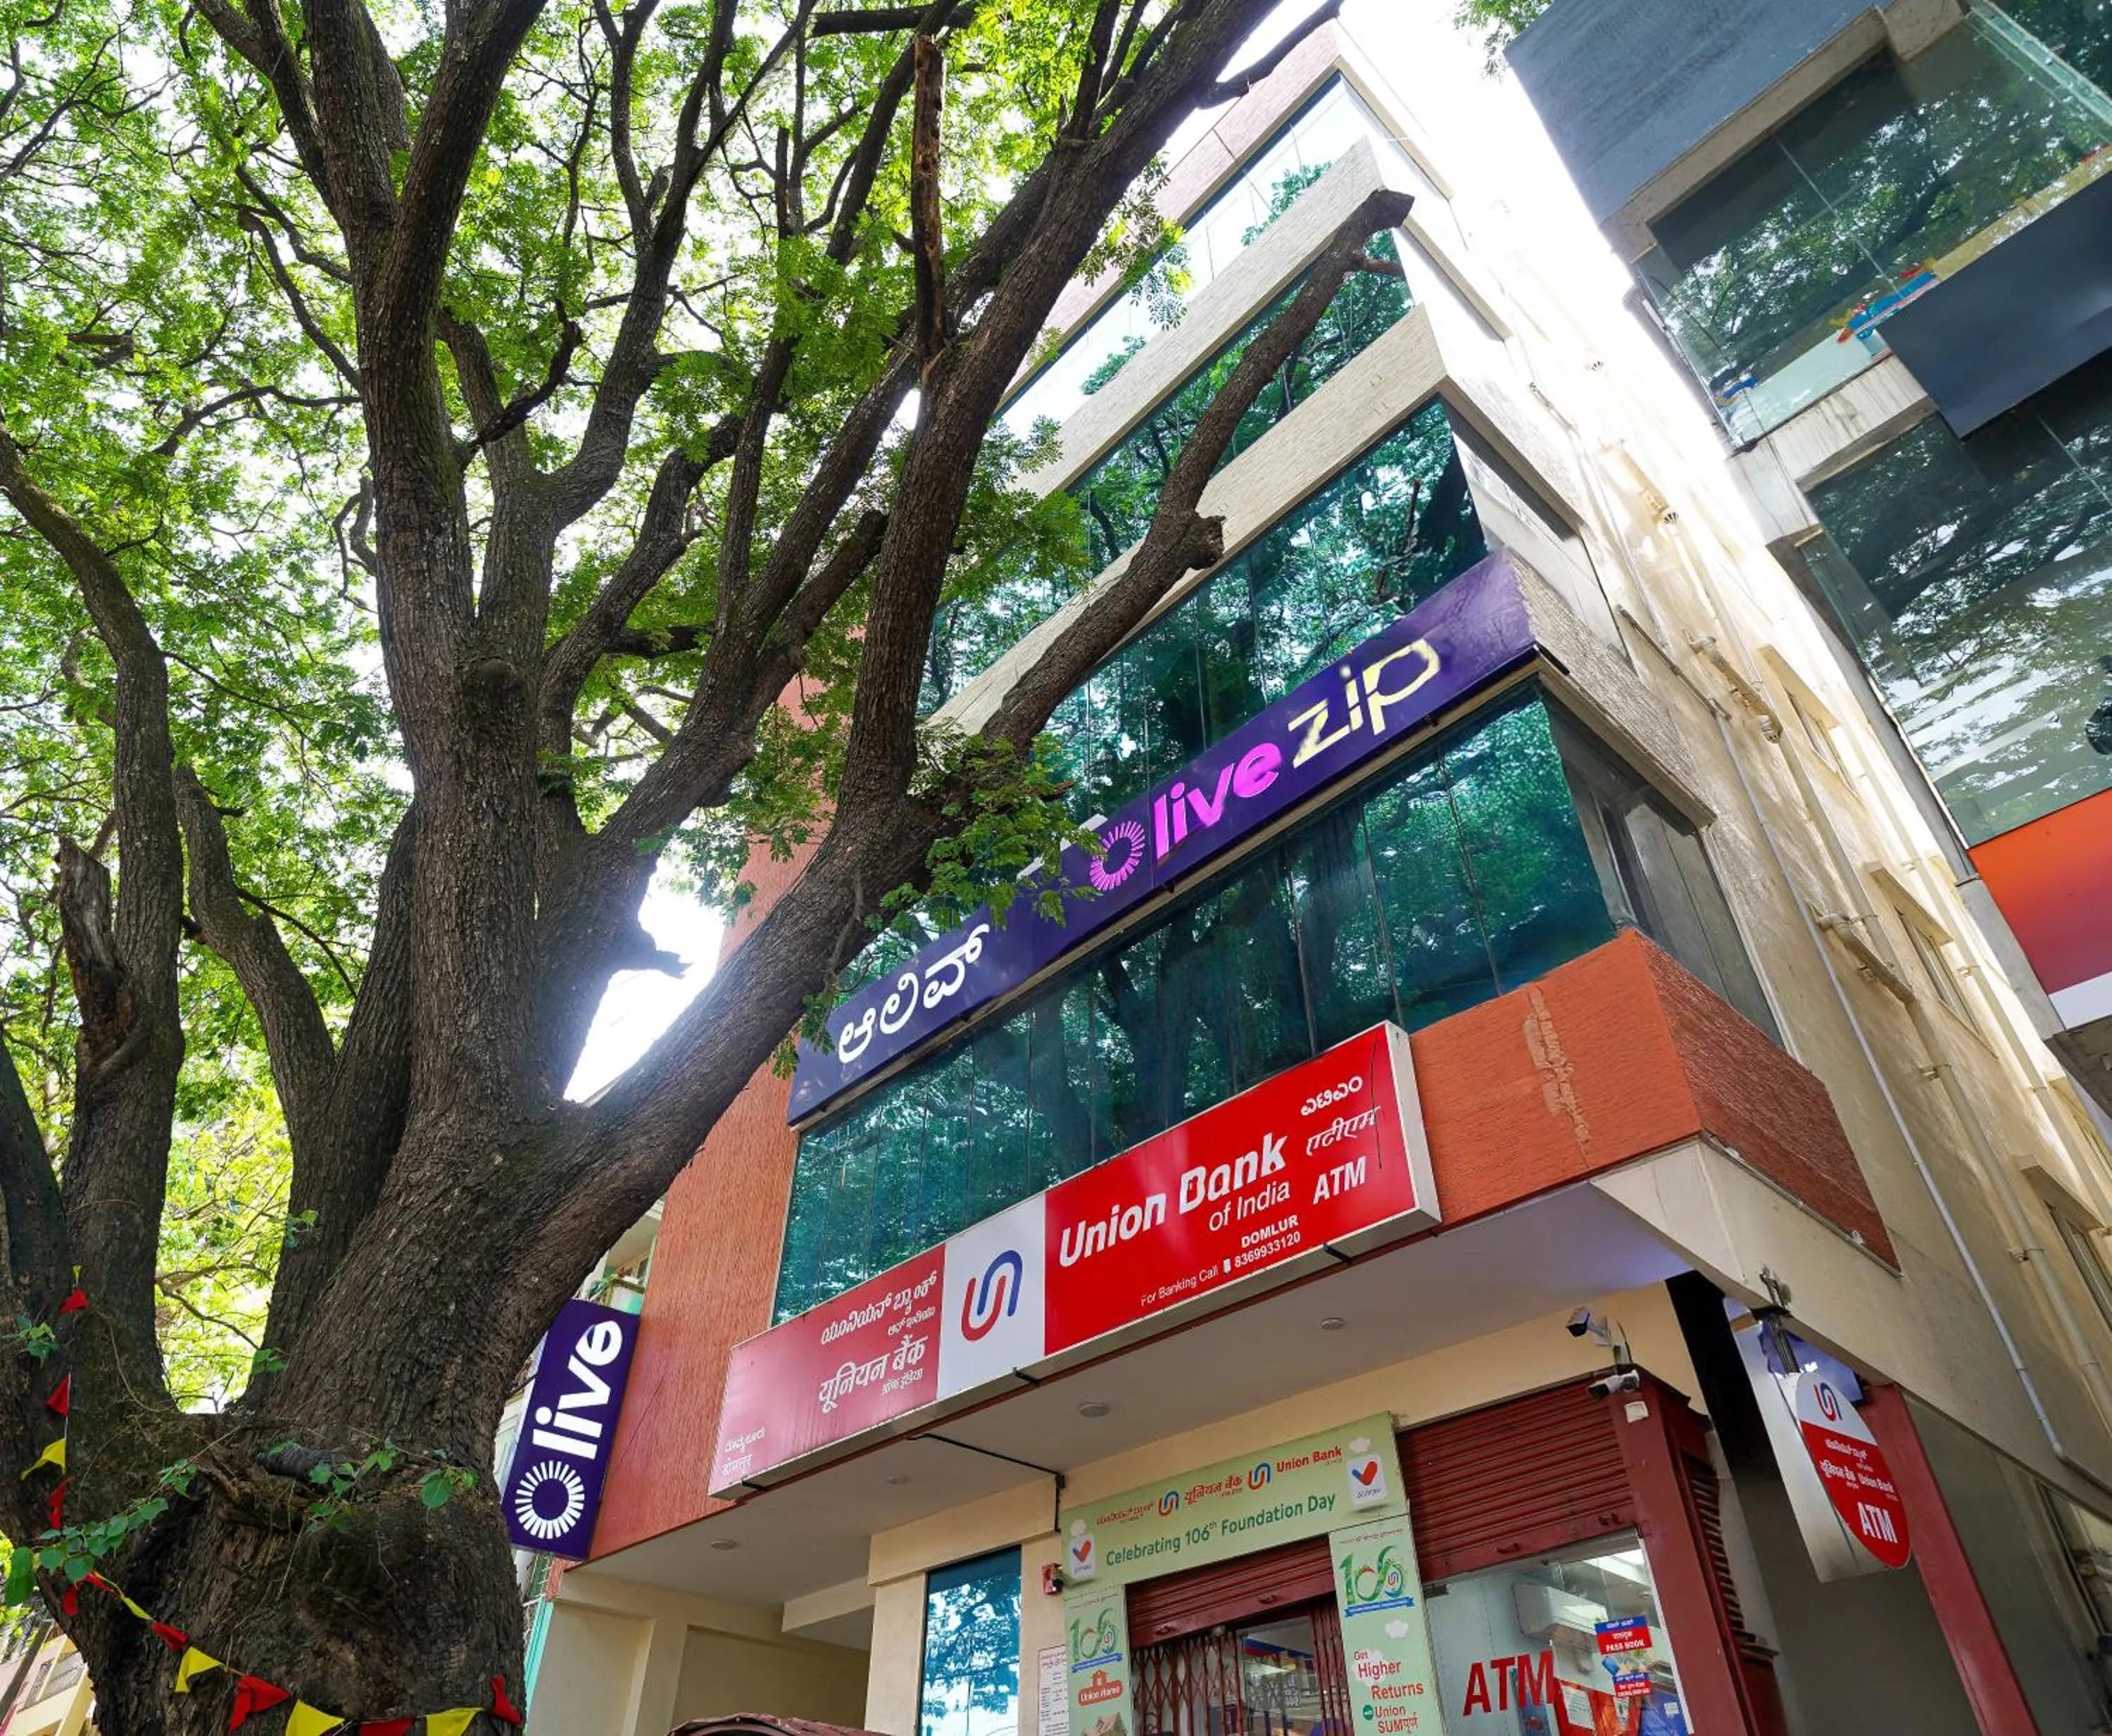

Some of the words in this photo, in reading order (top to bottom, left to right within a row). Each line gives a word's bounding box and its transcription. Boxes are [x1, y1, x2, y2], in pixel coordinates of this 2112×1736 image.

[1288, 638, 1440, 769] zip
[1306, 1105, 1381, 1157] एटीएम
[1059, 1191, 1167, 1269] Union
[1179, 1132, 1288, 1214] Bank
[1312, 1155, 1366, 1204] ATM
[1209, 1200, 1231, 1232] of
[1237, 1180, 1290, 1221] India
[1240, 1215, 1299, 1248] DOMLUR
[1141, 1292, 1157, 1307] For
[1158, 1276, 1198, 1300] Banking
[1199, 1264, 1219, 1282] Call
[1235, 1231, 1301, 1268] 8369933120
[819, 1352, 891, 1414] यूनियन
[893, 1334, 929, 1371] बैंक
[1276, 1457, 1309, 1473] Union
[1312, 1445, 1341, 1462] Bank
[1106, 1535, 1181, 1566] Celebrating
[1221, 1502, 1303, 1536] Foundation
[1307, 1493, 1336, 1512] Day
[1856, 1502, 1899, 1544] ATM
[1358, 1661, 1401, 1680] Higher
[1371, 1682, 1425, 1700] Returns
[1463, 1649, 1554, 1716] ATM
[1375, 1706, 1406, 1718] Union
